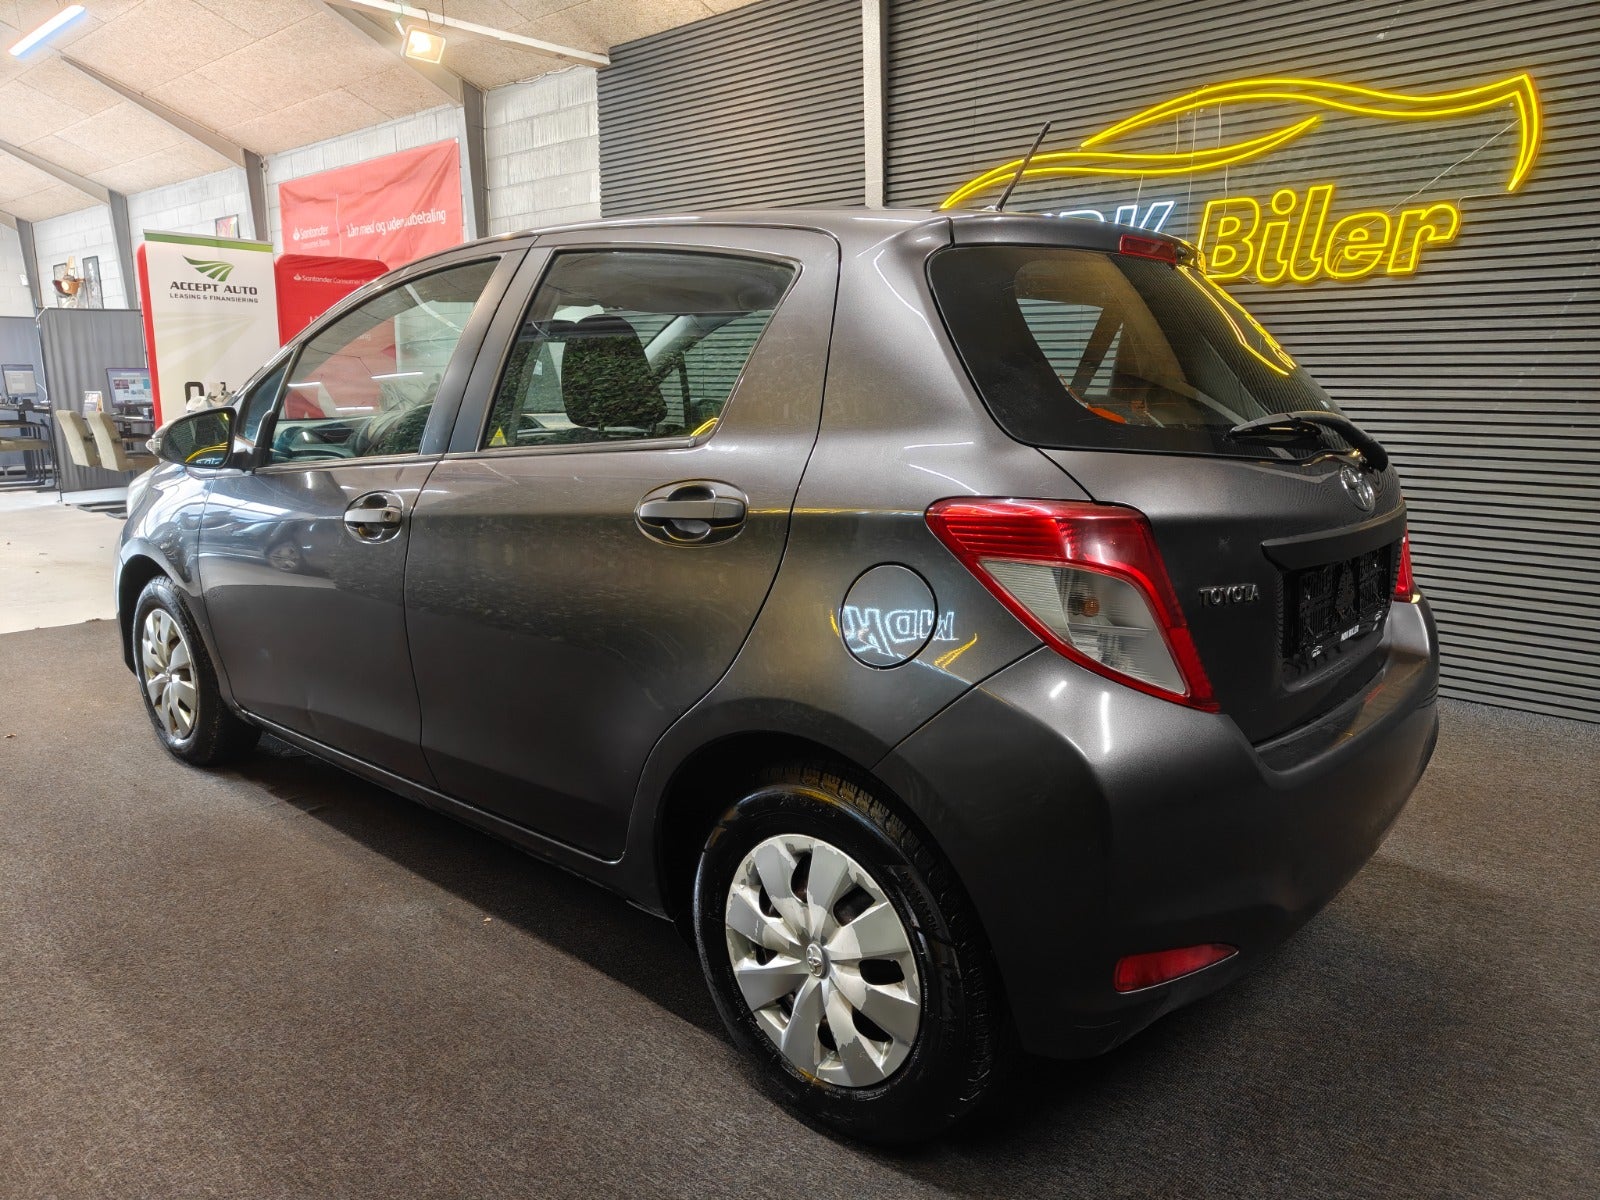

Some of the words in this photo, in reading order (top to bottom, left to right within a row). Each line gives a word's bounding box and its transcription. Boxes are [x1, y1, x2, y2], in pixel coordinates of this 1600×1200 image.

[300, 224, 329, 240] Santander
[360, 219, 375, 235] med
[375, 222, 387, 236] og
[387, 216, 404, 233] uden
[1197, 184, 1459, 282] Biler
[170, 281, 219, 293] ACCEPT
[223, 285, 258, 295] AUTO
[302, 275, 332, 284] Santander
[333, 277, 361, 285] Consumer
[209, 295, 259, 303] FINANSIERING
[1199, 584, 1260, 605] TOYOTA
